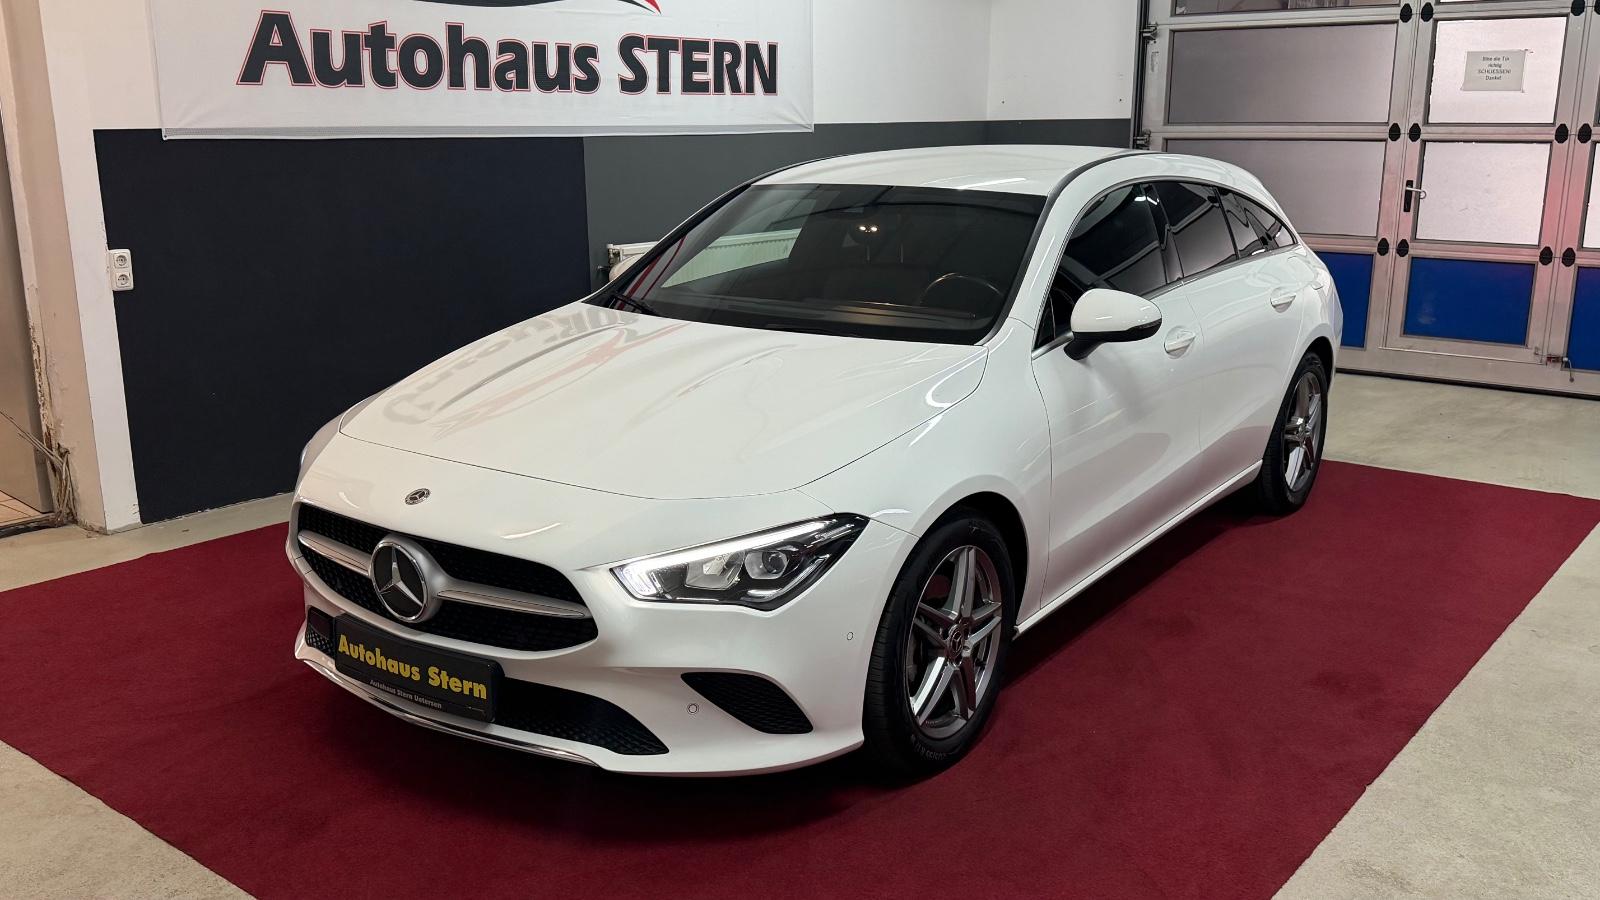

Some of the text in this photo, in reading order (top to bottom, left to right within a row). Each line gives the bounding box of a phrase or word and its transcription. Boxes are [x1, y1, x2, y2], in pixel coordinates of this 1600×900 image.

[236, 10, 779, 95] Autohaus STERN
[337, 634, 487, 700] Autohaus Stern
